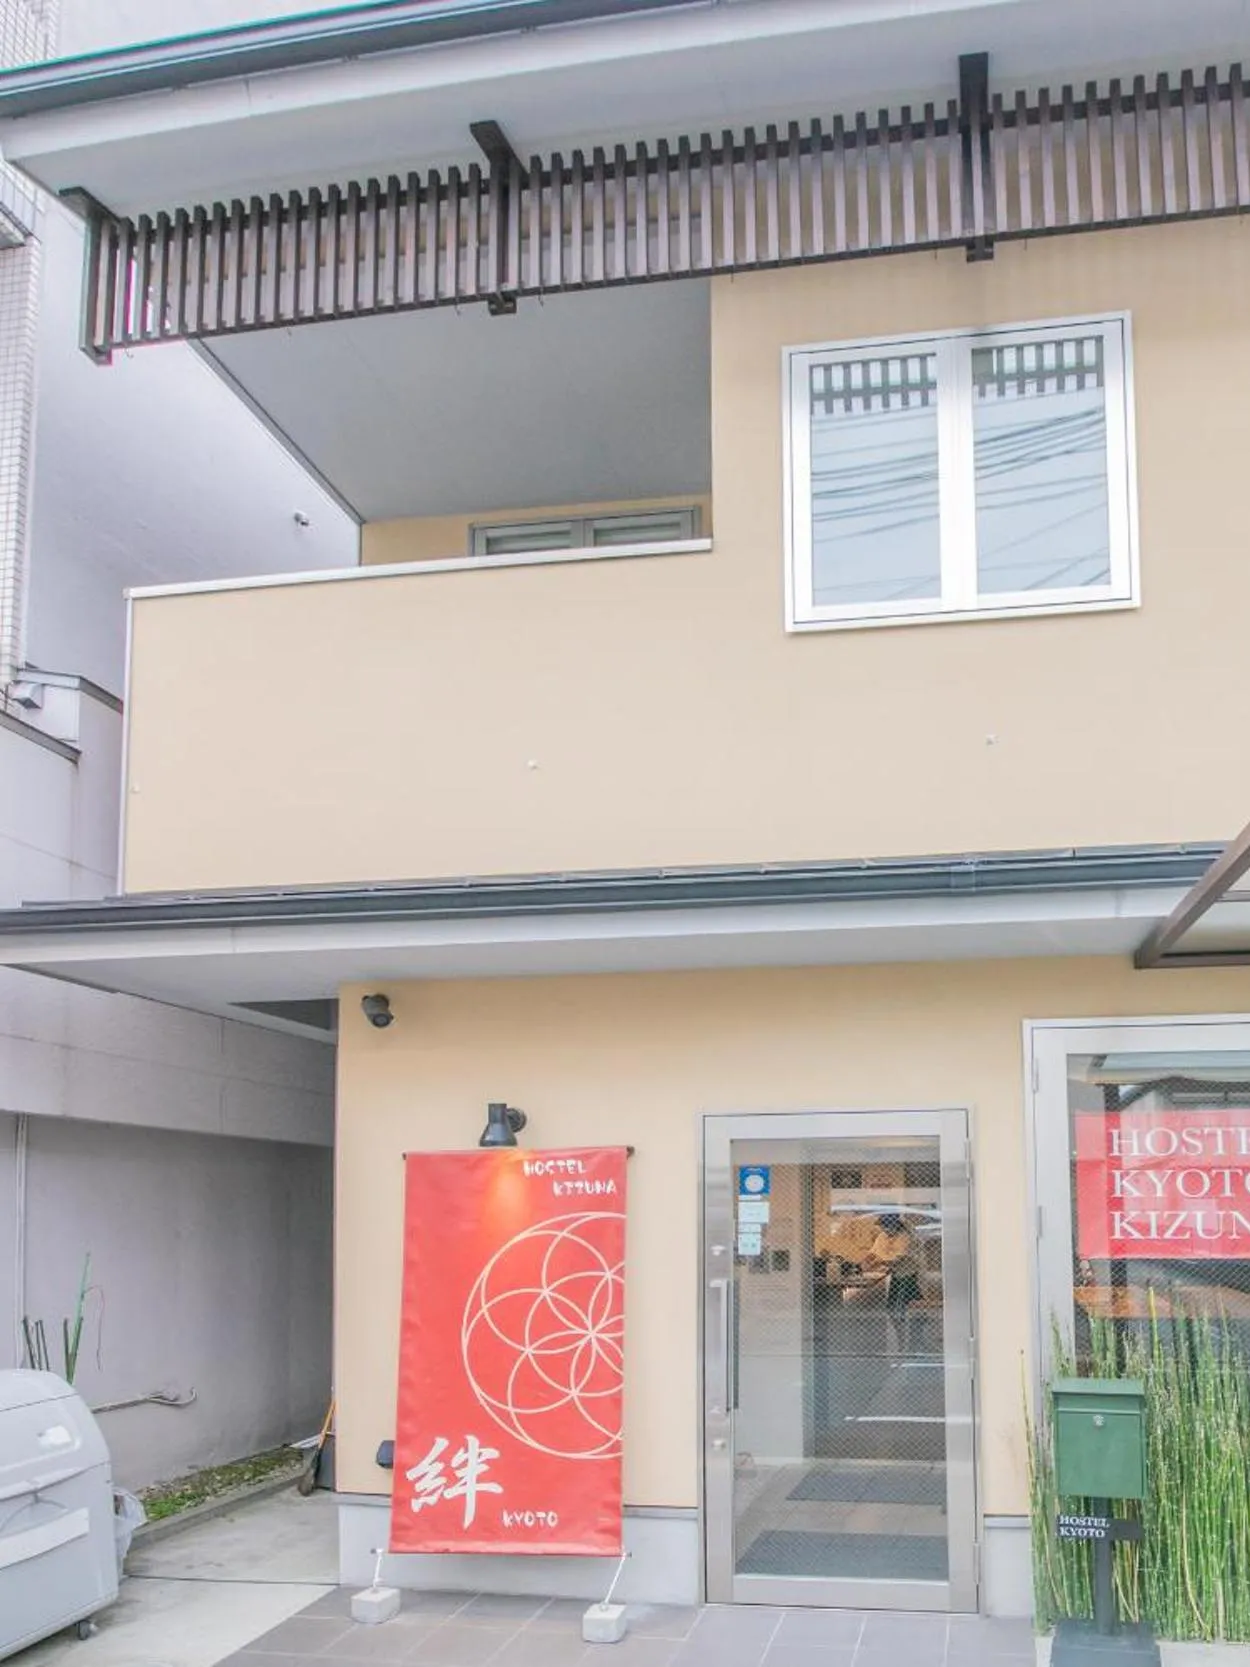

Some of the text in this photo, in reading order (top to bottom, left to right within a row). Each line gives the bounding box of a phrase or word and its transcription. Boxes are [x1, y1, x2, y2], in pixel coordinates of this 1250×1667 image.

[523, 1159, 587, 1177] HOSTEL
[406, 1434, 504, 1531] 絆
[502, 1509, 558, 1528] KYOTO
[1060, 1514, 1110, 1528] HOSTEL
[1060, 1526, 1105, 1538] KYOTO
